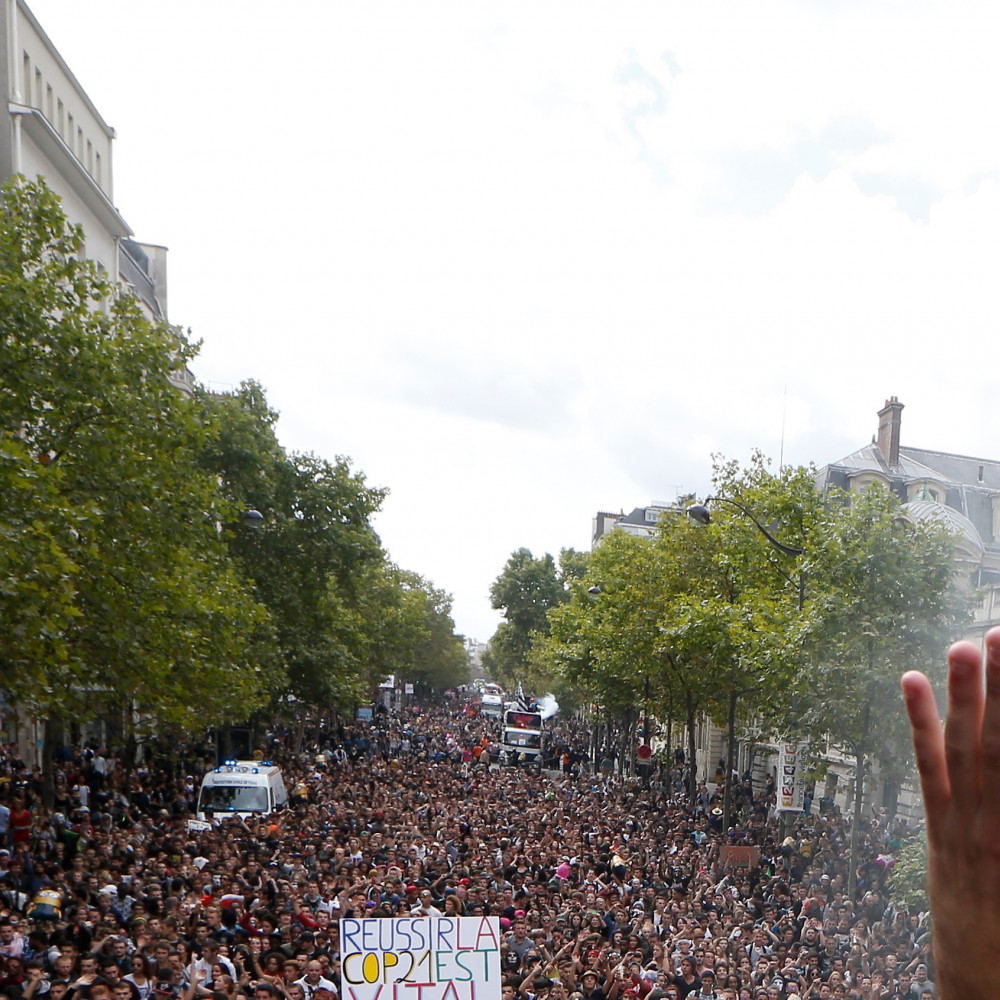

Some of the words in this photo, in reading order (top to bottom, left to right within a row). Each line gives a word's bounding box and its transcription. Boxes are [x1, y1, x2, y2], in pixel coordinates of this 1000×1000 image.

[342, 918, 454, 953] REUSSIR
[456, 915, 499, 951] LA
[342, 949, 434, 984] COP21
[435, 948, 497, 982] EST
